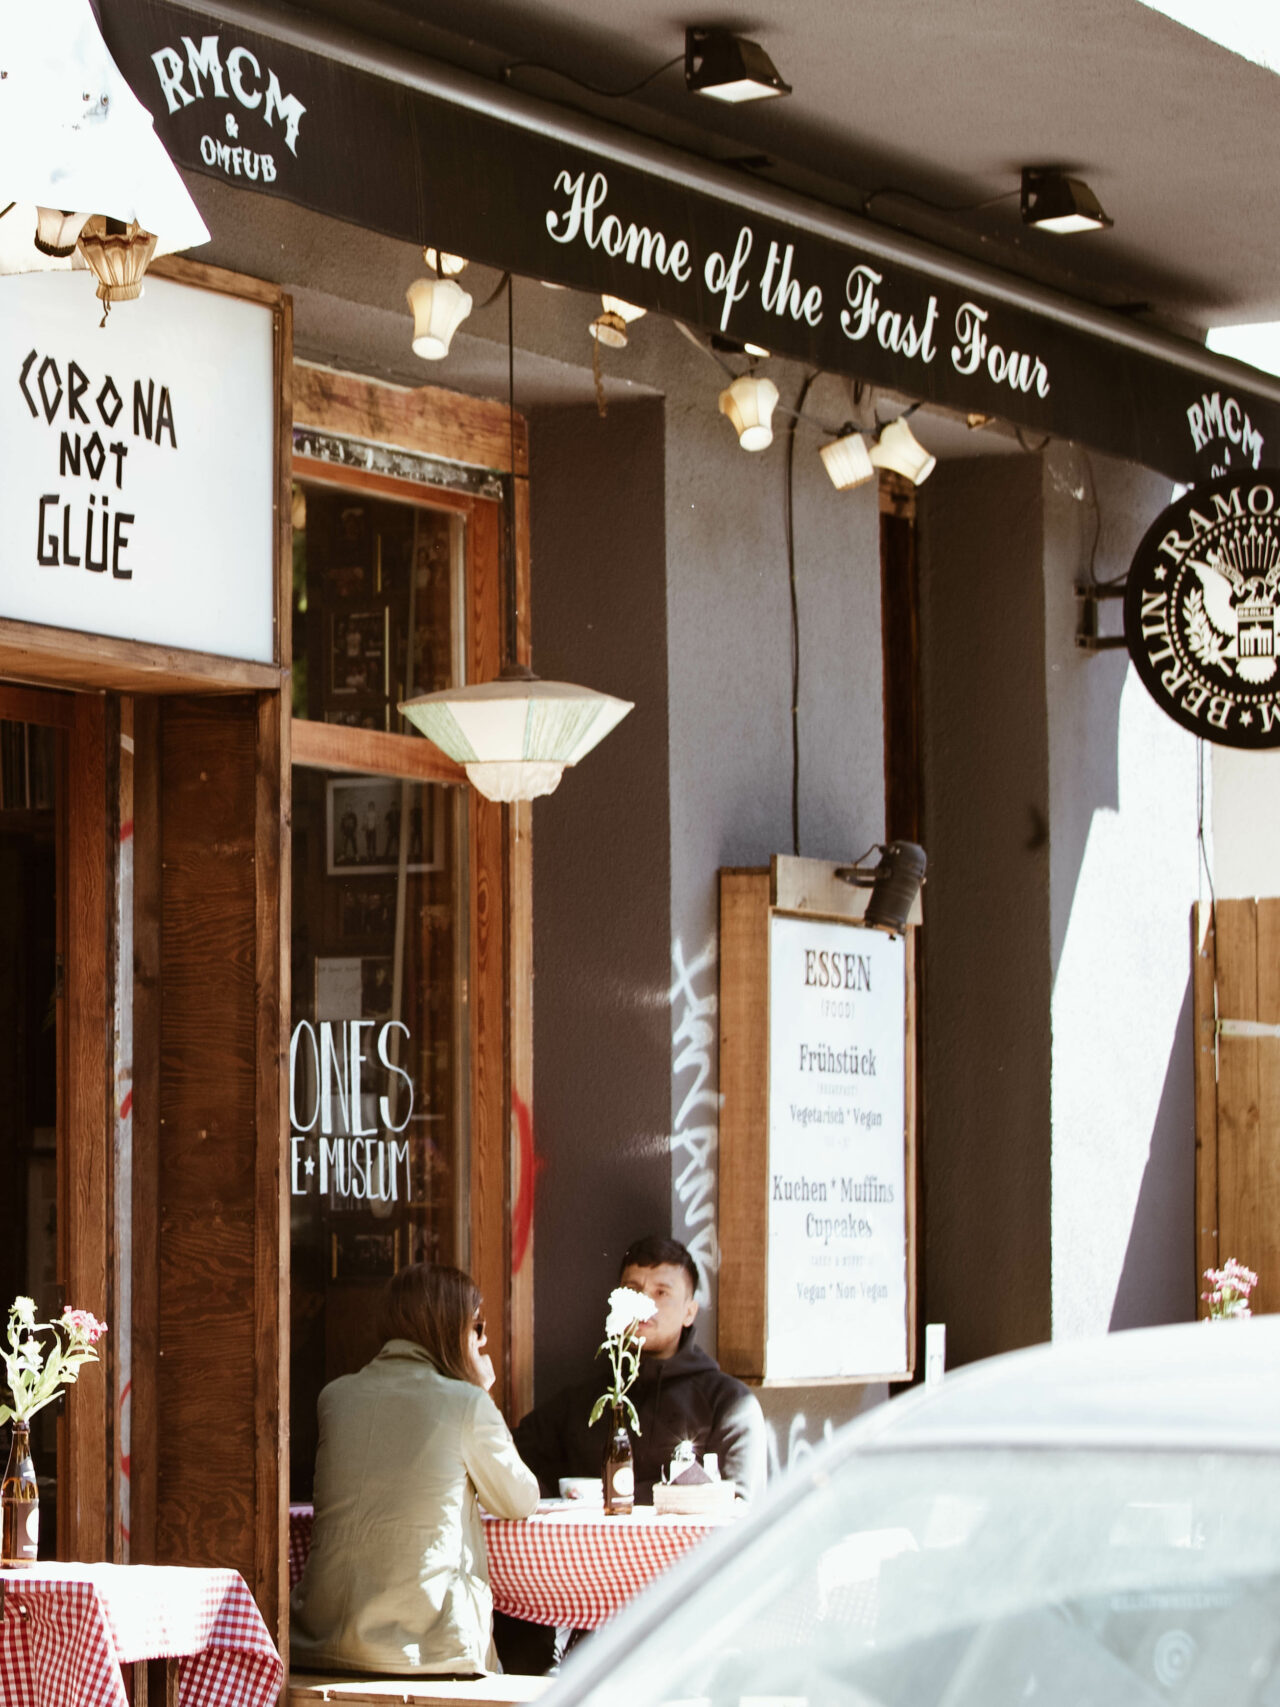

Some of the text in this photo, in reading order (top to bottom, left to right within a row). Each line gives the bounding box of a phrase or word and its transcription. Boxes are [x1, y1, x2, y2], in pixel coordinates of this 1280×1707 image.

[151, 36, 307, 158] RMCM
[226, 113, 238, 139] &
[200, 135, 278, 182] OMFUB
[546, 170, 1050, 398] Home of the Fast Four
[19, 349, 177, 449] CORONA
[60, 431, 127, 489] NOT
[1187, 392, 1264, 470] RMCM
[37, 495, 135, 579] GLÜE
[1158, 485, 1280, 563] RAMO
[1142, 589, 1236, 730] BERLIN
[804, 949, 872, 992] ESSEN
[290, 1020, 414, 1136] ONES
[799, 1043, 877, 1076] Frühstück
[853, 1108, 883, 1129] Vegan
[320, 1137, 412, 1202] MUSEUM
[773, 1175, 895, 1203] Kuchen Muffins
[806, 1212, 873, 1245] Cupcakes
[796, 1283, 826, 1304] Vegan
